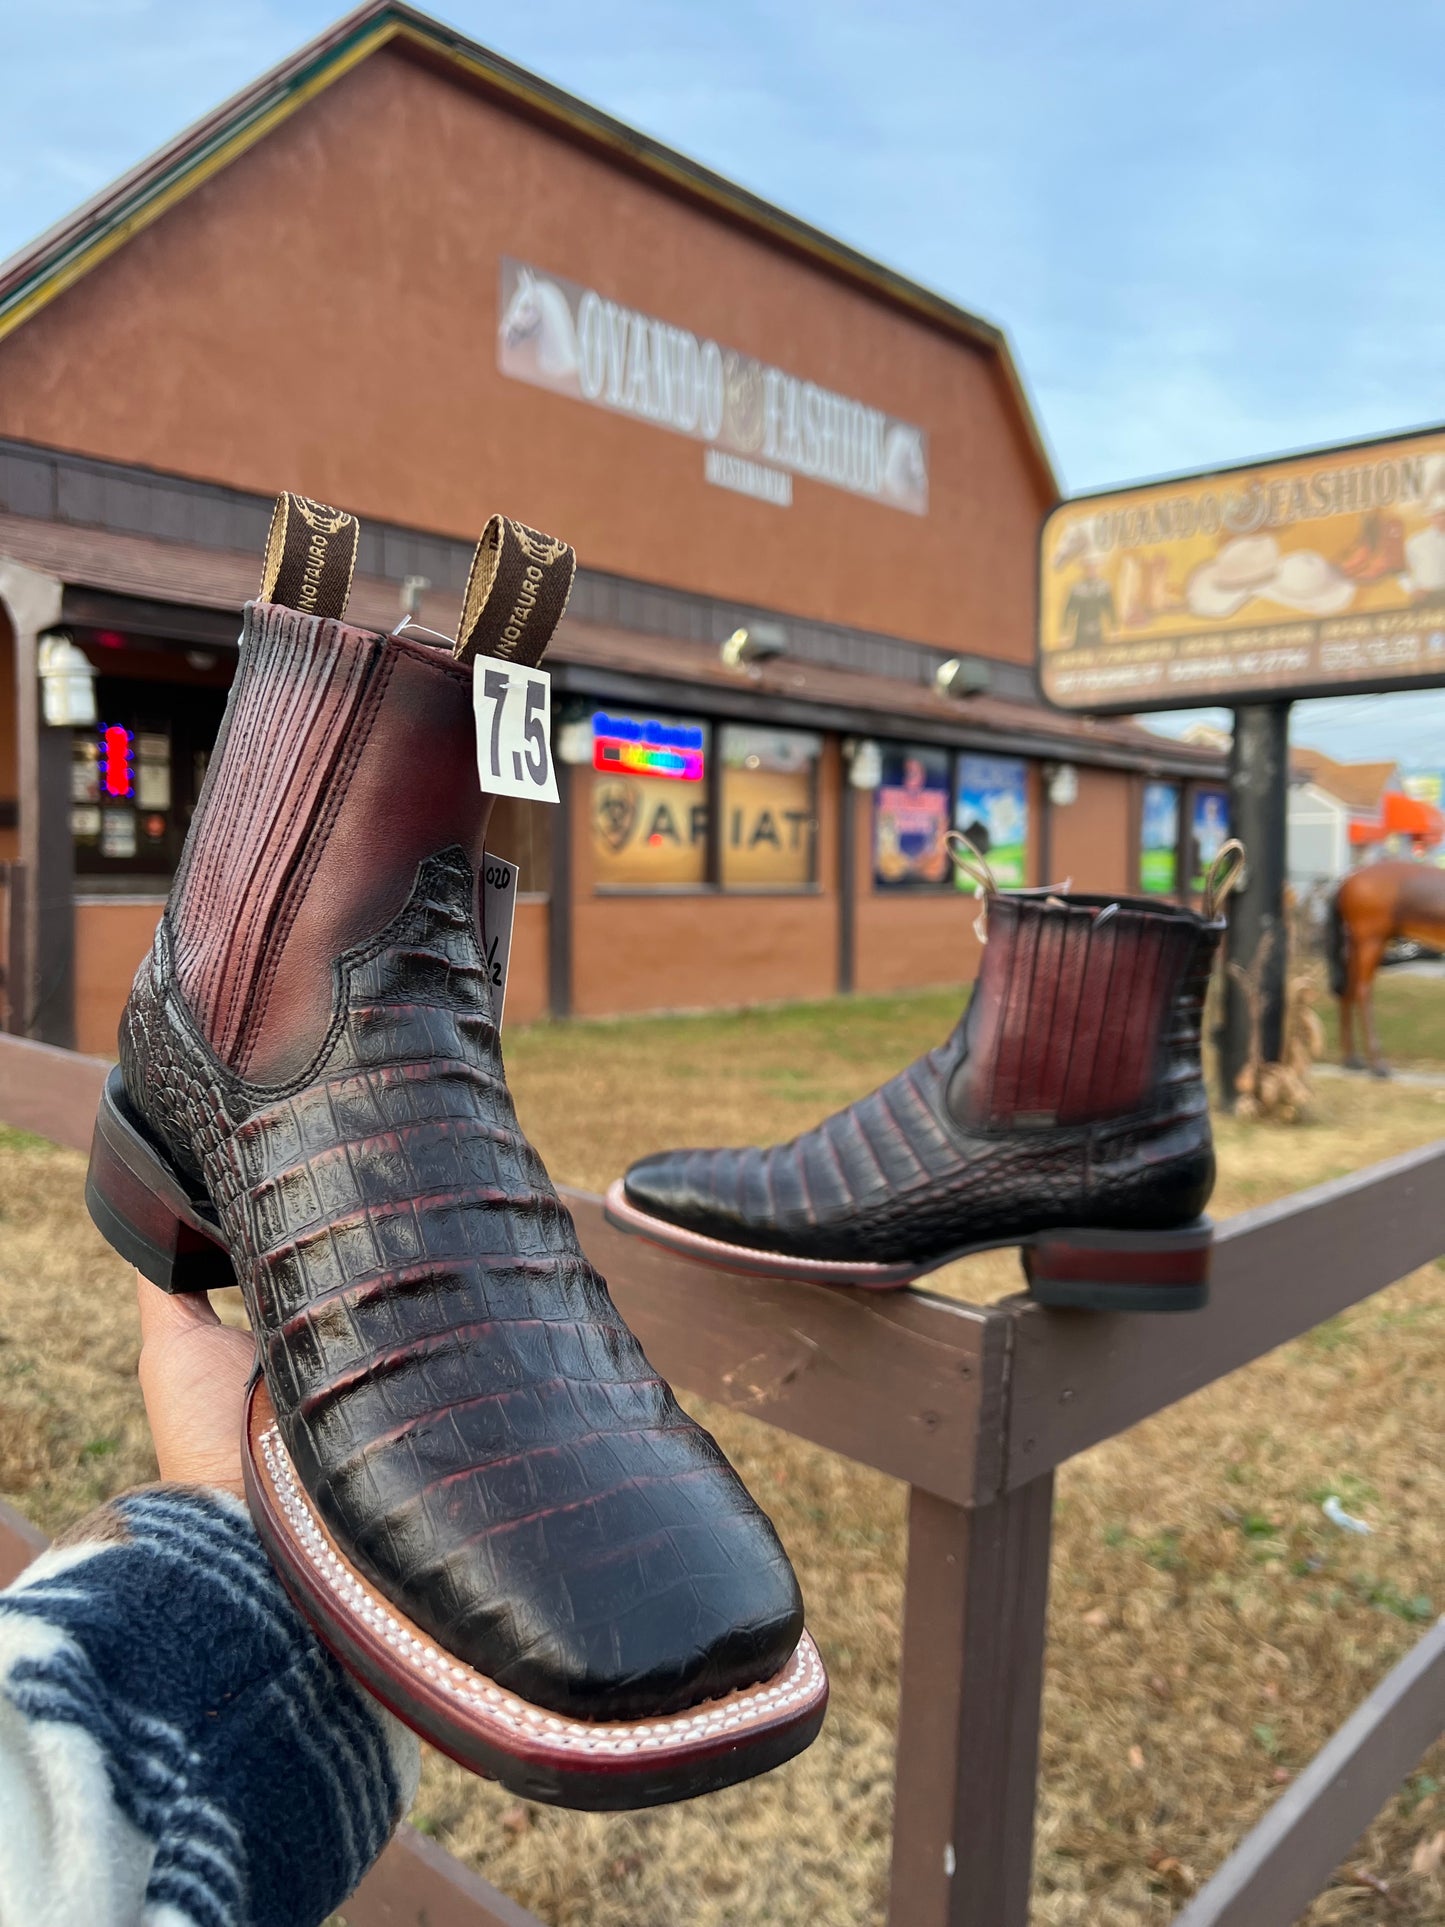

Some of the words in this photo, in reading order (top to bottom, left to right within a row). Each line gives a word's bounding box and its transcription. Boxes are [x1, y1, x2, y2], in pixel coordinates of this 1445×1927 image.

[577, 289, 724, 440] OVANDO
[762, 366, 886, 494] FASHION
[1265, 455, 1428, 528] FASHION
[296, 533, 329, 614] INOTAURO
[493, 565, 545, 659] INOTAURO
[484, 669, 548, 786] 7.5
